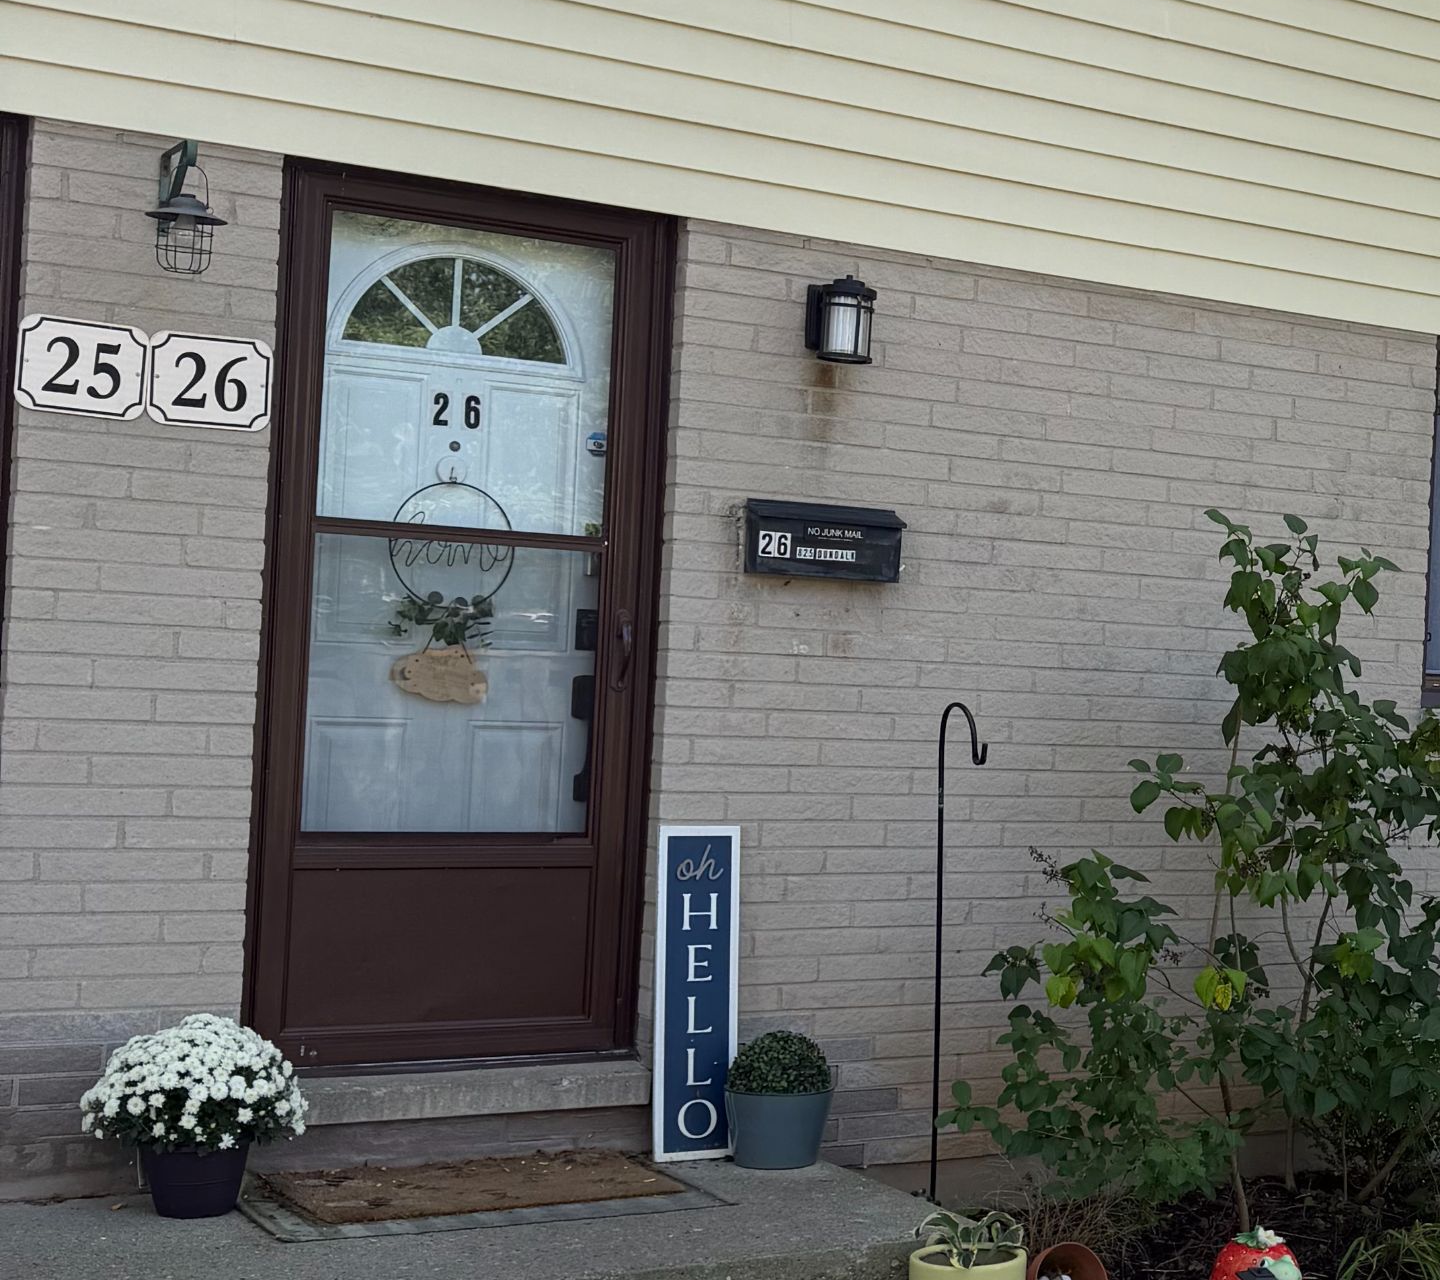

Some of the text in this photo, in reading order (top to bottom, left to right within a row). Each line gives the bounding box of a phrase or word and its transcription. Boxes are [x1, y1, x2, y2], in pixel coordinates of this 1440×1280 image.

[41, 334, 122, 400] 25
[170, 349, 250, 413] 26
[432, 392, 481, 430] 26
[760, 532, 789, 556] 26
[807, 527, 820, 536] NO
[822, 528, 843, 538] JUNK
[844, 529, 864, 539] MAIL
[675, 843, 724, 882] oh
[677, 892, 719, 1140] HELLO
